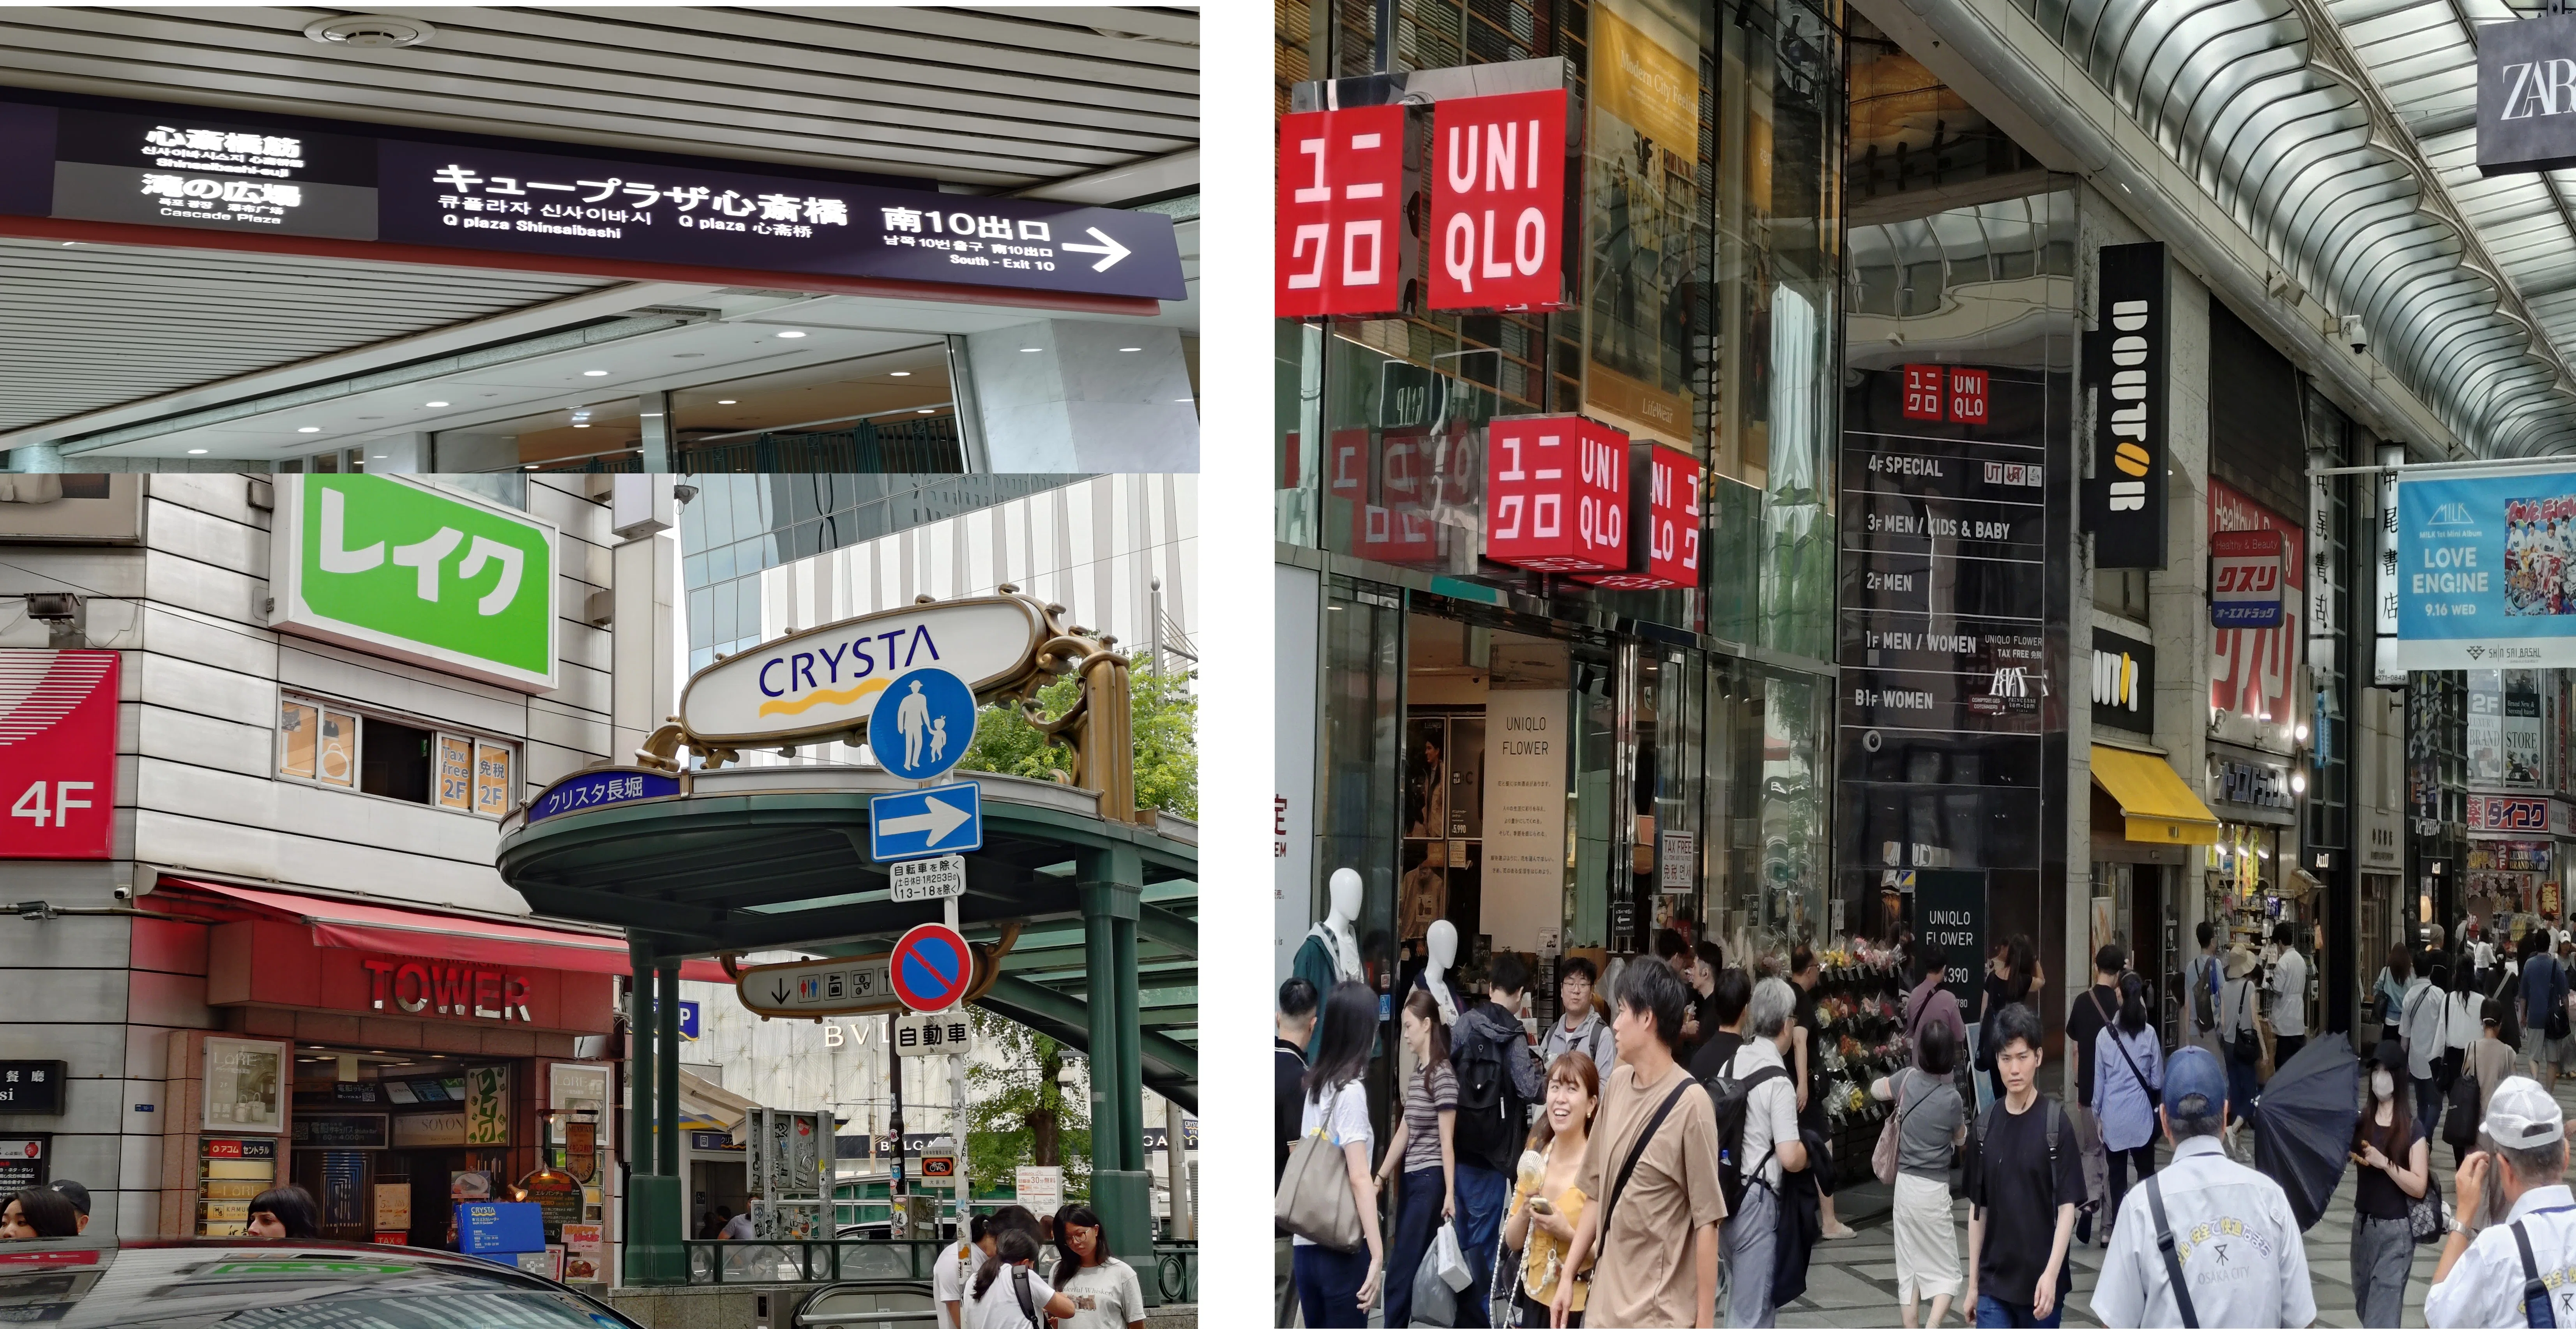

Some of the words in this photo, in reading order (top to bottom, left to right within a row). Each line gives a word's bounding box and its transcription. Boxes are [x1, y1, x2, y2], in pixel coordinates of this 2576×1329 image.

[1620, 50, 1652, 88] Modern
[1654, 74, 1671, 103] City
[156, 158, 290, 177] Shinsaibashi-suji
[1448, 120, 1539, 194] UNI
[1295, 133, 1383, 203] ユニ
[141, 173, 300, 206] 滝の広場
[433, 164, 848, 226] キュープラザ心斎橋
[161, 208, 231, 220] Cascade
[237, 214, 281, 224] Plaza
[438, 195, 531, 215] 큐플라자
[540, 204, 651, 225] 신사이바시
[443, 215, 458, 226] Q
[464, 216, 510, 230] plaza
[516, 220, 621, 238] Shinsaibashi
[679, 215, 693, 227] Q
[700, 217, 745, 232] plaza
[881, 206, 1050, 241] 南10出口
[883, 235, 915, 246] 남쪽
[953, 240, 984, 252] 출구
[991, 244, 1053, 257] 南10出口
[1288, 220, 1382, 289] クロ
[1445, 207, 1545, 293] QLO
[950, 254, 989, 266] South
[1003, 258, 1030, 270] Exit
[1035, 261, 1055, 271] 10
[1909, 371, 1937, 391] ユニ
[1954, 375, 1981, 395] UNI
[1642, 398, 1673, 424] LifeWear
[1908, 394, 1937, 413] クロ
[1954, 397, 1983, 418] QLO
[2110, 300, 2150, 511] DOUTOR
[1499, 436, 1561, 480] ユニ
[1581, 437, 1618, 492] UNI
[1868, 454, 1883, 472] 4F
[1886, 455, 1943, 477] SPECIAL
[1986, 464, 2001, 481] UT
[1495, 494, 1560, 539] クロ
[1580, 495, 1620, 550] QLO
[1868, 514, 1882, 531] 3F
[1885, 515, 1913, 533] MEN
[1928, 518, 1957, 536] KIDS
[1961, 520, 1971, 537] &
[1975, 521, 2010, 540] BABY
[320, 487, 523, 616] レイク
[2216, 540, 2241, 550] Healthy
[2245, 540, 2249, 549] &
[2253, 539, 2278, 549] Beauty
[2383, 472, 2398, 619] 中尾書店
[2425, 547, 2476, 568] LOVE
[1867, 572, 1882, 589] 2F
[1884, 573, 1912, 592] MEN
[2216, 566, 2277, 592] クスリ
[2413, 572, 2488, 594] ENG!NE
[2425, 604, 2447, 616] 9.16
[2452, 604, 2476, 614] WED
[1866, 630, 1879, 648] 1F
[1883, 632, 1911, 650] MEN
[1927, 634, 1976, 653] WOMEN
[1985, 634, 2010, 645] UNIQLO
[2014, 635, 2042, 646] FLOWER
[759, 624, 940, 697] CRYSTA
[1997, 648, 2010, 658] TAX
[2012, 649, 2029, 658] FREE
[1855, 689, 1878, 706] B1F
[1883, 690, 1933, 710] WOMEN
[2472, 694, 2498, 713] 2F
[1506, 716, 1547, 733] UNIQLO
[2469, 717, 2495, 727] LUXURY
[1502, 741, 1549, 756] FLOWER
[2469, 729, 2500, 747] BRAND
[2507, 731, 2537, 748] STORE
[442, 745, 465, 763] Tax
[442, 760, 468, 779] free
[479, 759, 505, 779] 免税
[444, 778, 466, 800] 2F
[480, 785, 502, 806] 2F
[548, 775, 643, 814] クリスタ長堀
[11, 781, 94, 827] 4F
[2487, 800, 2545, 828] ダイコク
[1664, 839, 1675, 853] TAX
[1677, 840, 1692, 854] FREE
[894, 860, 959, 876] 自転車を除く
[1929, 910, 1970, 926] UNIQLO
[364, 959, 531, 1022] TOWER
[680, 1008, 690, 1026] P
[899, 1022, 967, 1048] 自動車
[243, 1146, 269, 1154] セントラル
[2198, 1268, 2230, 1285] OSAKA
[2231, 1266, 2250, 1280] CITY
[1085, 1287, 1113, 1297] Whiskers
